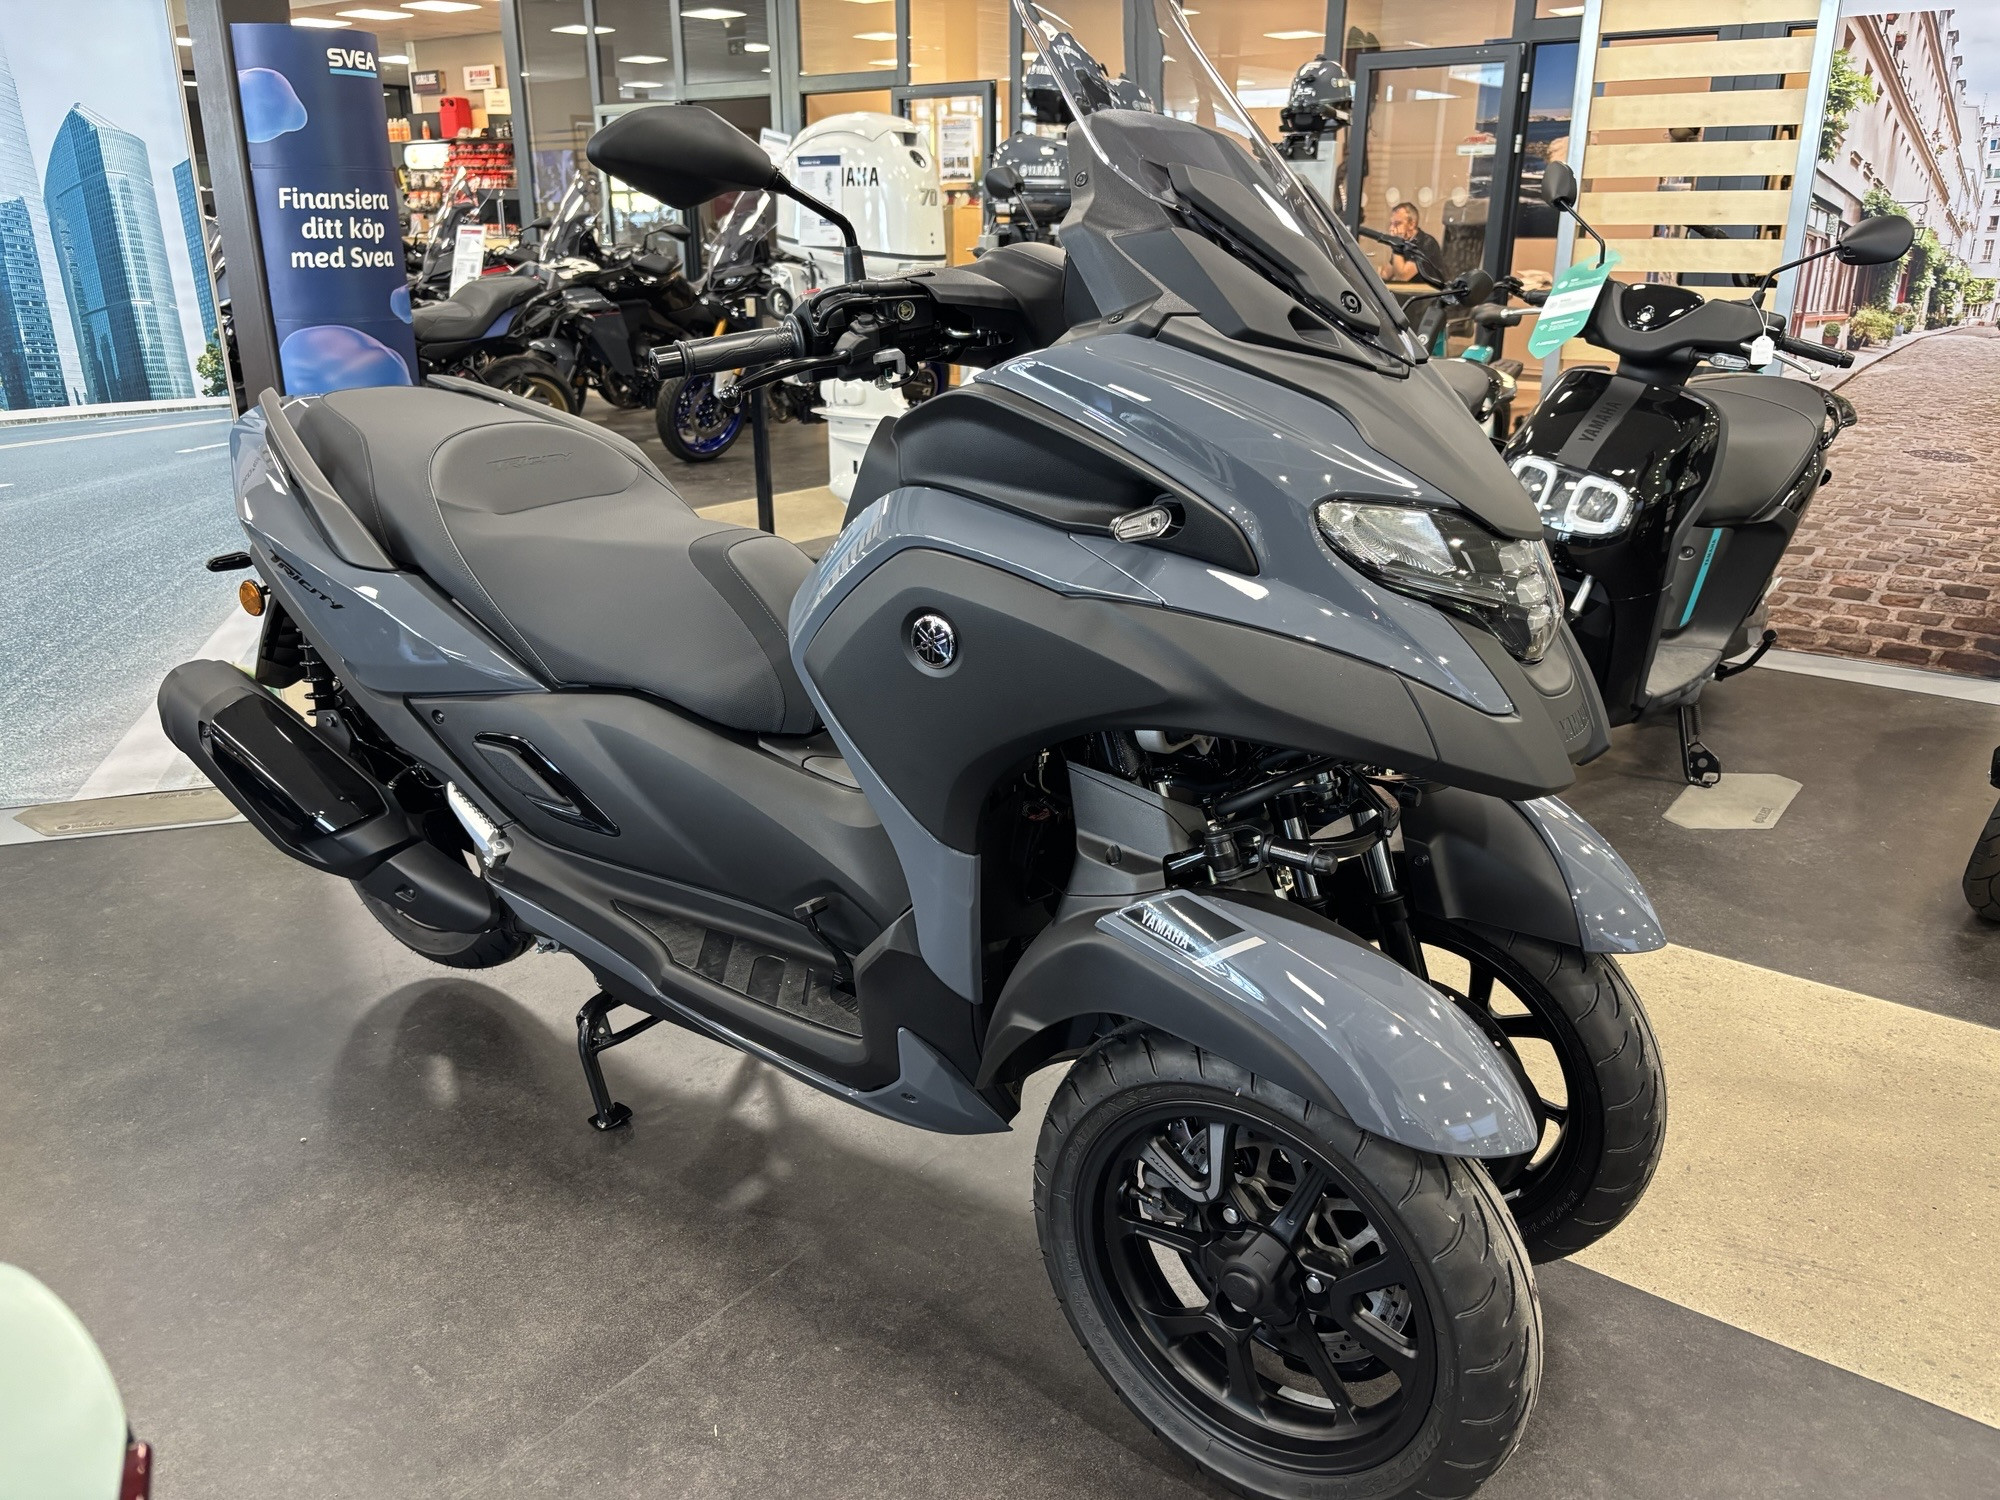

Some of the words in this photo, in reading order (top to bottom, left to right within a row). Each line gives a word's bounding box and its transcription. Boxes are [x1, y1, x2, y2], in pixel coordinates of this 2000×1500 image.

[326, 47, 377, 71] SVEA
[278, 187, 390, 210] Finansiera
[919, 188, 938, 206] 70
[301, 216, 343, 239] ditt
[349, 216, 385, 244] köp
[291, 245, 346, 268] med
[350, 247, 395, 268] Svea
[1579, 402, 1622, 441] YAMAHA
[1704, 538, 1717, 566] YAMAHA
[269, 549, 346, 609] TRICITY
[1141, 908, 1190, 950] YAMAHA
[1298, 1424, 1441, 1500] BRIDGESONE
